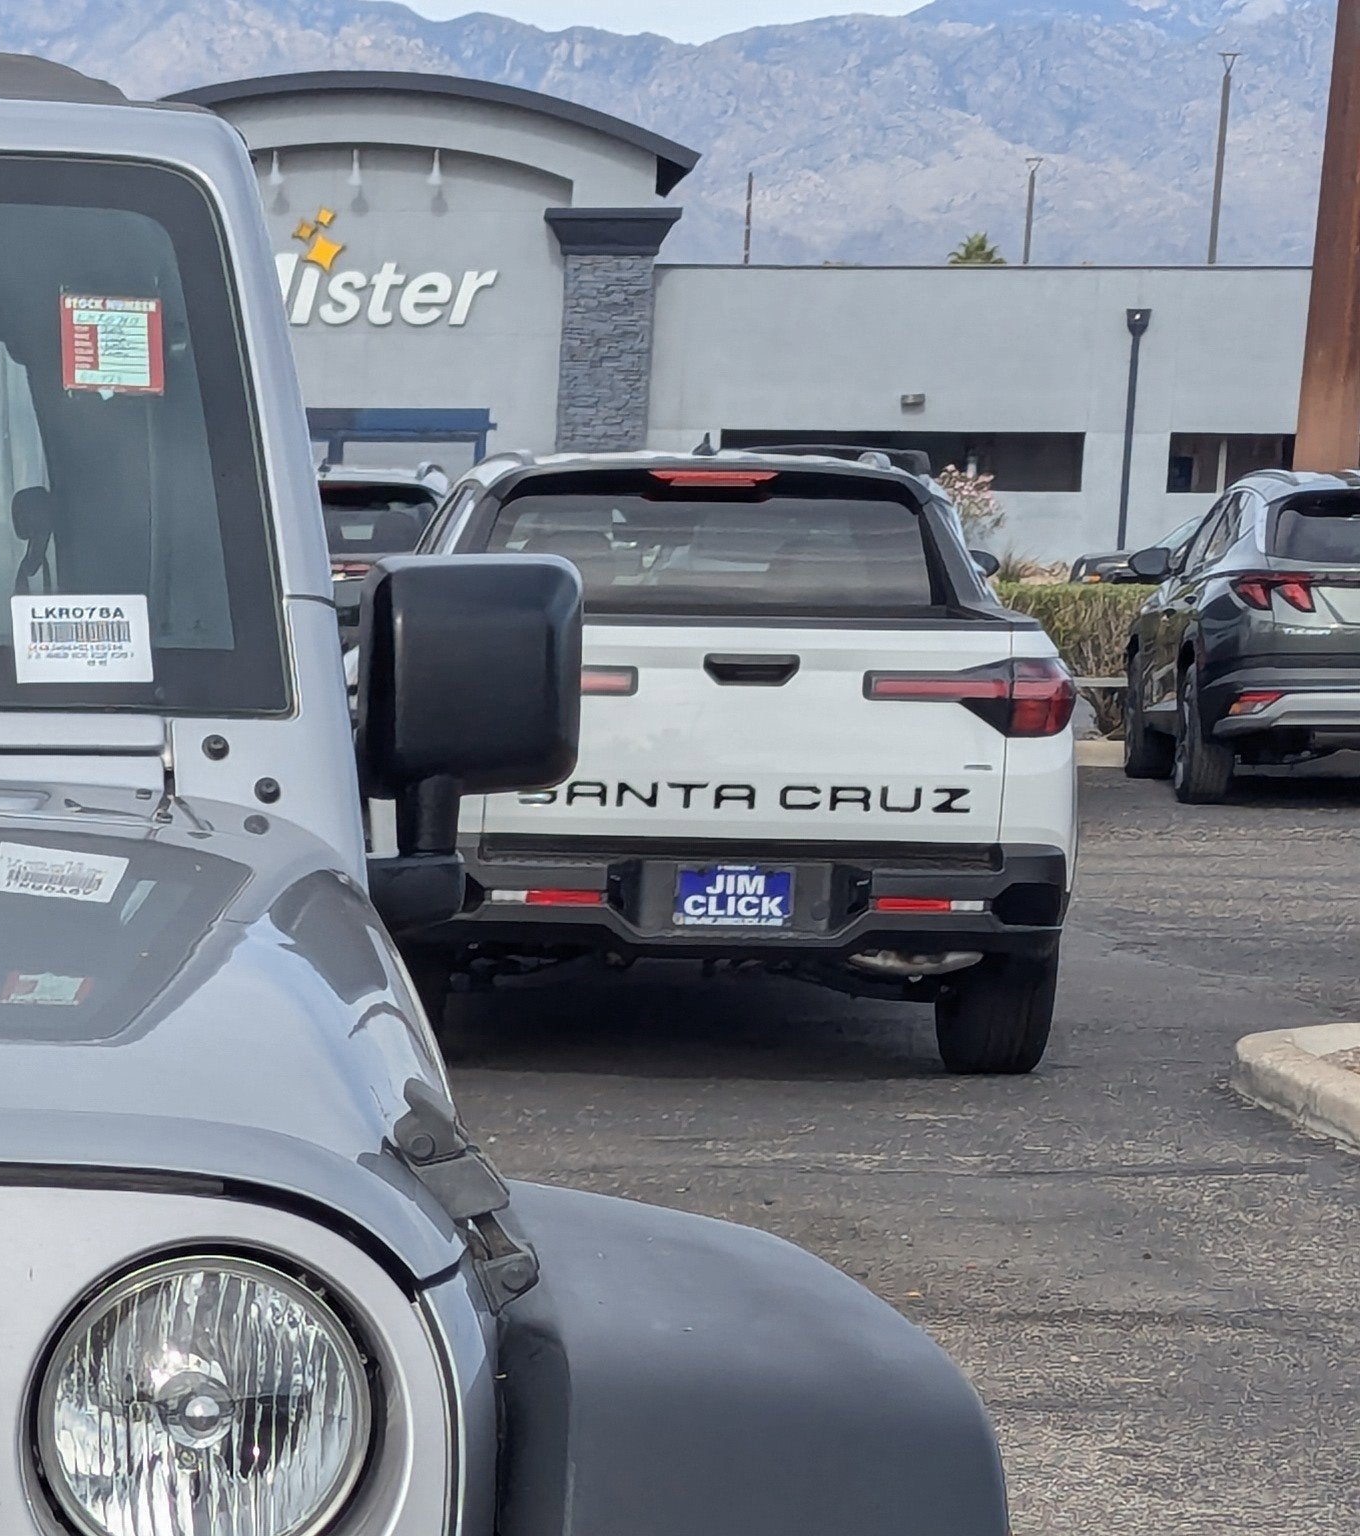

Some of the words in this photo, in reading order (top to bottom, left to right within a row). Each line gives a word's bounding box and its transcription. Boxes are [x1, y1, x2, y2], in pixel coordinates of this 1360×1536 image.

[518, 780, 757, 811] SANTA
[779, 784, 972, 814] CRUZ
[705, 874, 766, 895] JIM
[683, 894, 784, 917] CLICK
